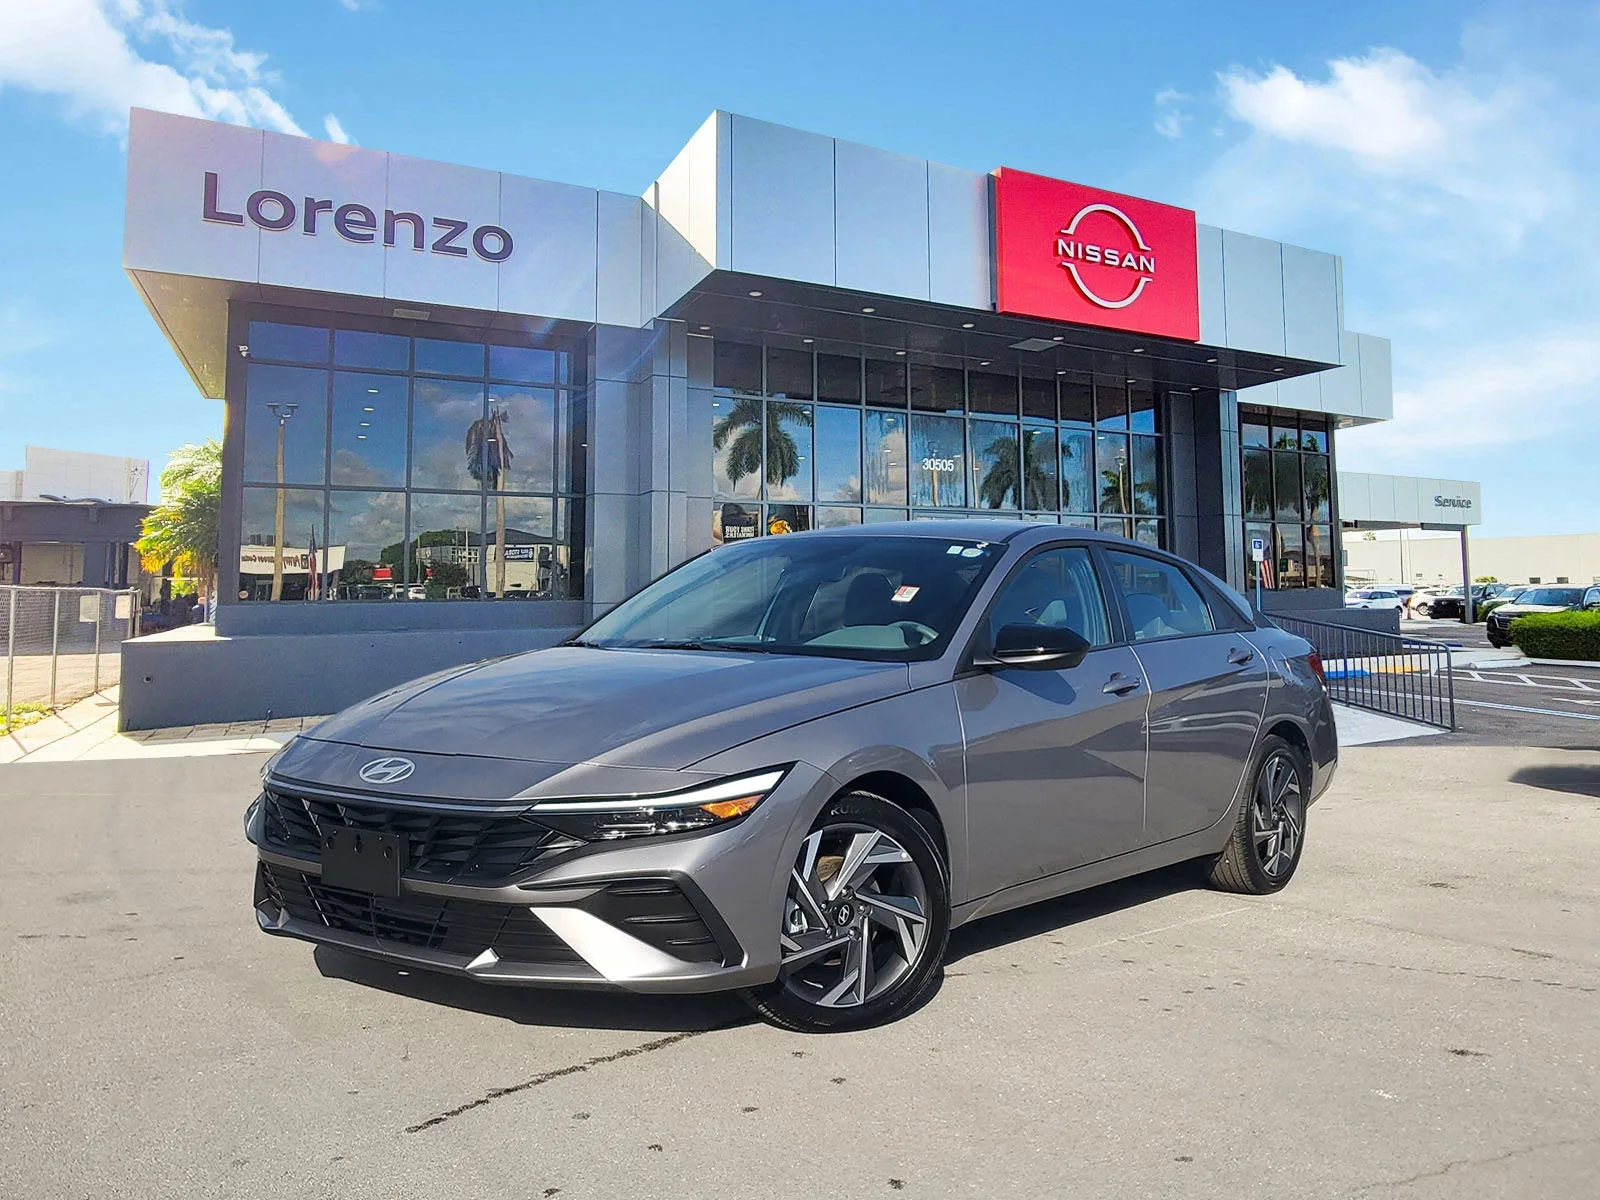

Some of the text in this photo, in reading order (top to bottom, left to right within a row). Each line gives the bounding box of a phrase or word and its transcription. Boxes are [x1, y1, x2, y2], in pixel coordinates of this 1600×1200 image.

[203, 171, 514, 262] Lorenzo
[1058, 238, 1155, 273] NISSAN
[922, 458, 954, 471] 30505
[1434, 495, 1472, 508] Service
